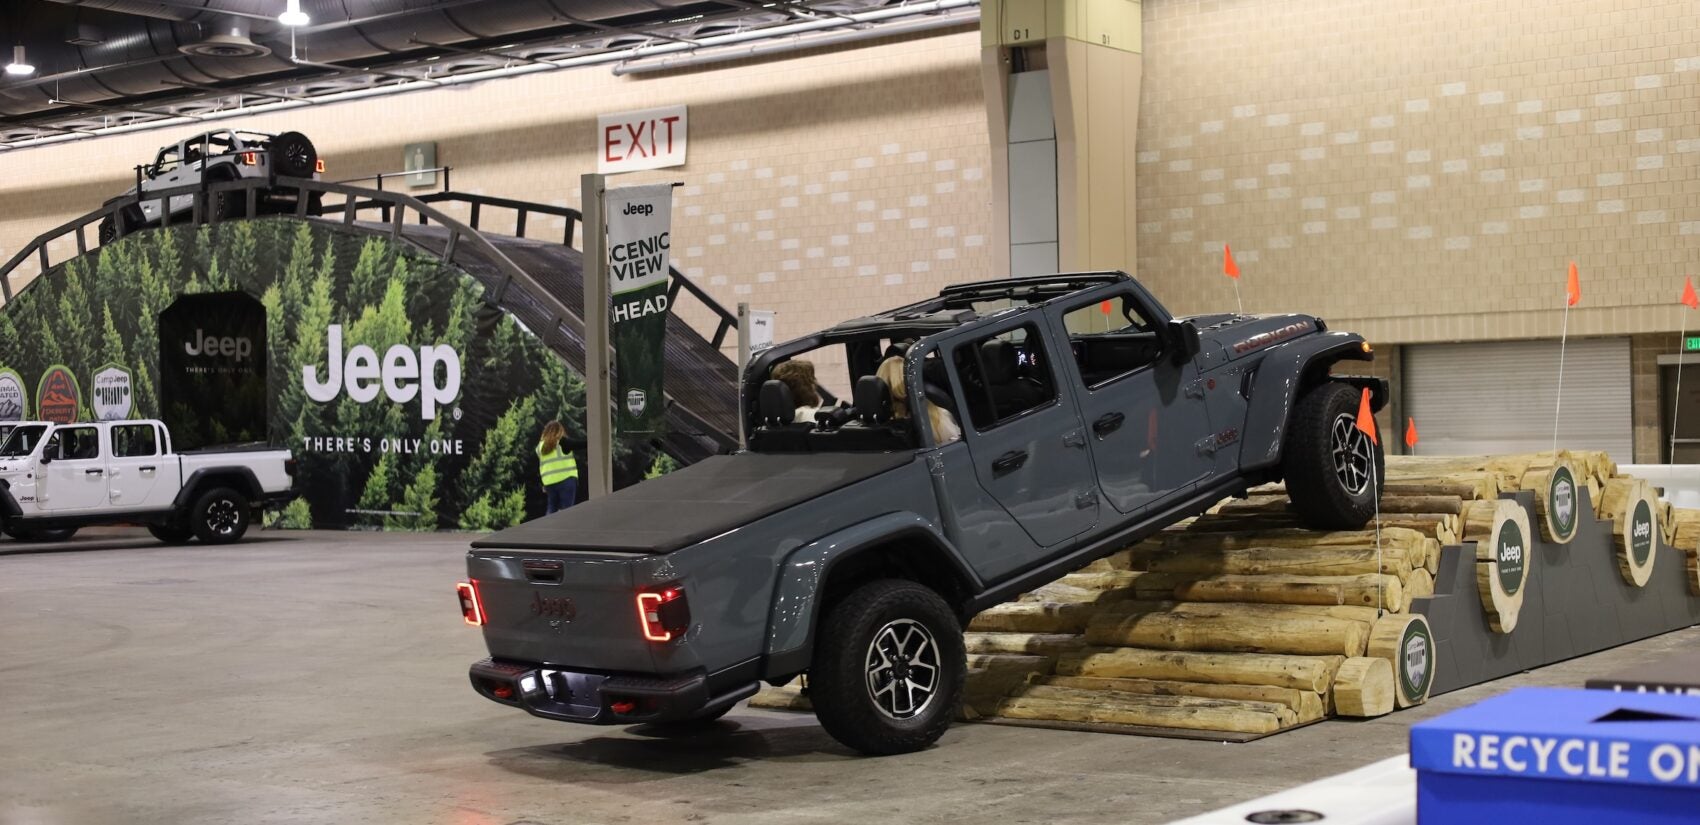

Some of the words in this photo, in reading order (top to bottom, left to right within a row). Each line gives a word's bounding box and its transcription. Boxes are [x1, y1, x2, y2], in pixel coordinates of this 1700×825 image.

[605, 115, 680, 162] EXIT
[623, 202, 654, 216] Jeep
[613, 253, 663, 281] VIEW
[185, 328, 252, 362] Jeep
[1232, 321, 1309, 353] RUBICON
[303, 324, 461, 420] Jeep
[303, 437, 372, 452] THERE'S
[380, 438, 421, 454] ONLY
[430, 439, 464, 455] ONE
[1633, 520, 1650, 538] Jeep
[1500, 542, 1521, 563] Jeep
[1452, 733, 1631, 778] RECYCLE
